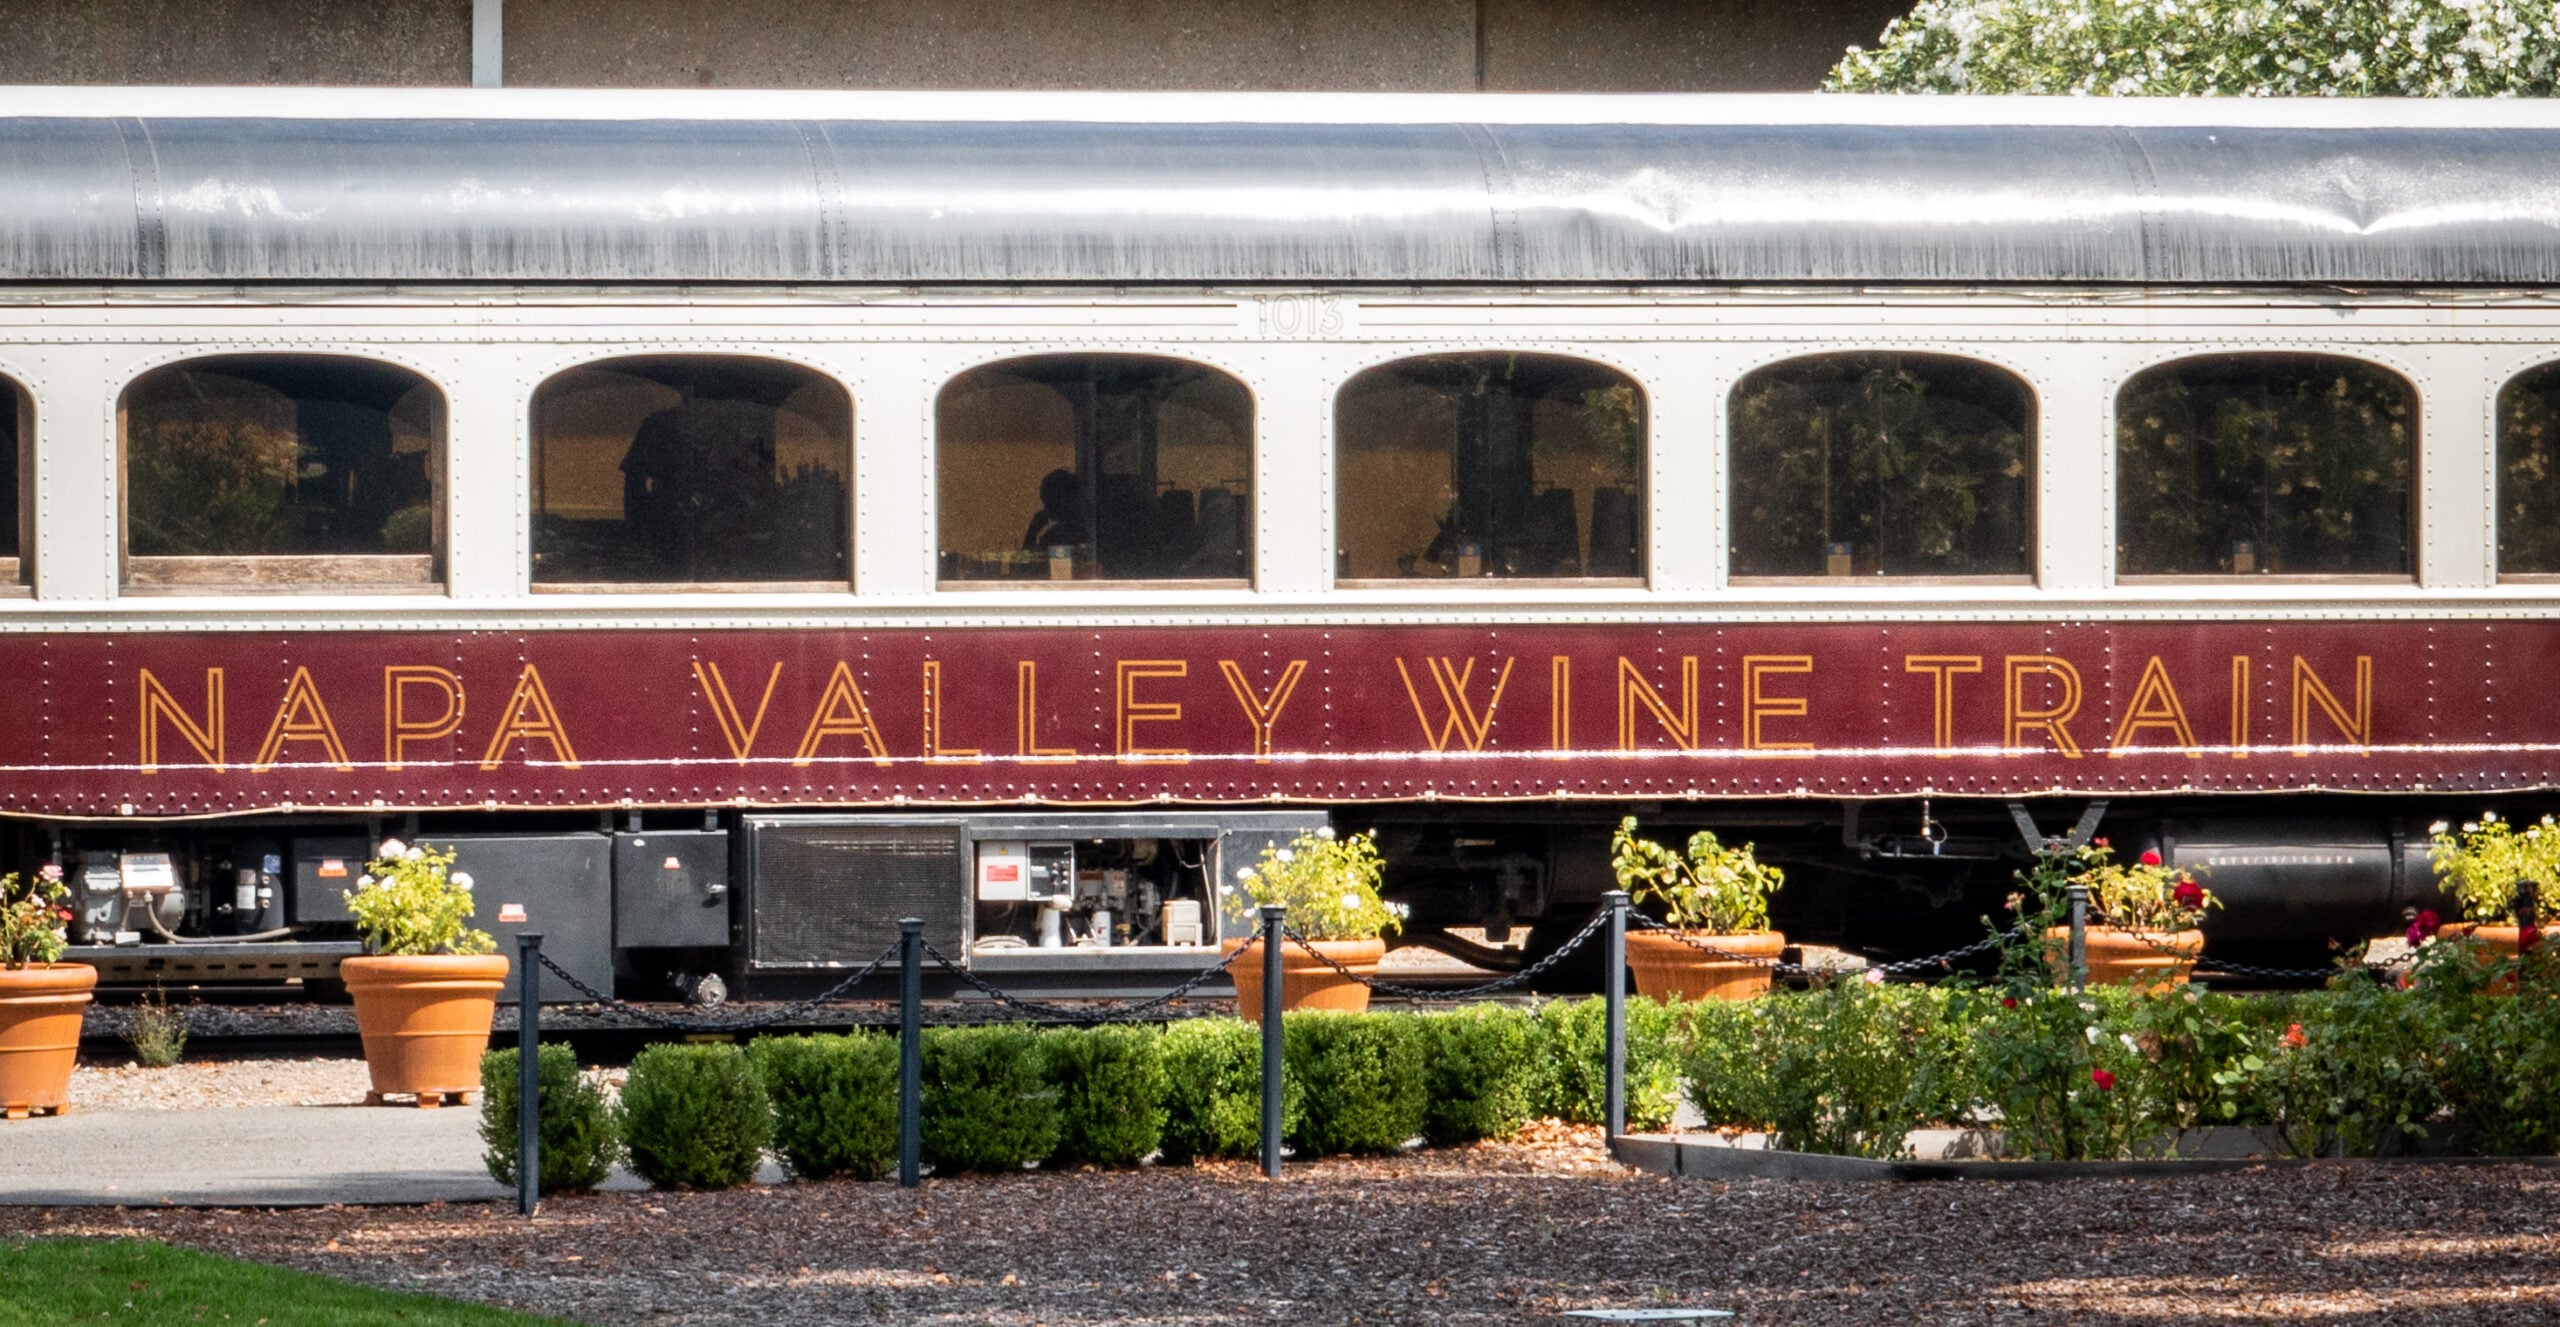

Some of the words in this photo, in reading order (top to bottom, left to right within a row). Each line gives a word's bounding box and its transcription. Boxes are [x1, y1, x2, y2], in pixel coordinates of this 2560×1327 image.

[1252, 294, 1343, 335] 1013
[139, 665, 582, 774] NAPA
[692, 660, 1308, 767] VALLEY
[1395, 655, 1815, 761] WINE
[1904, 654, 2372, 758] TRAIN
